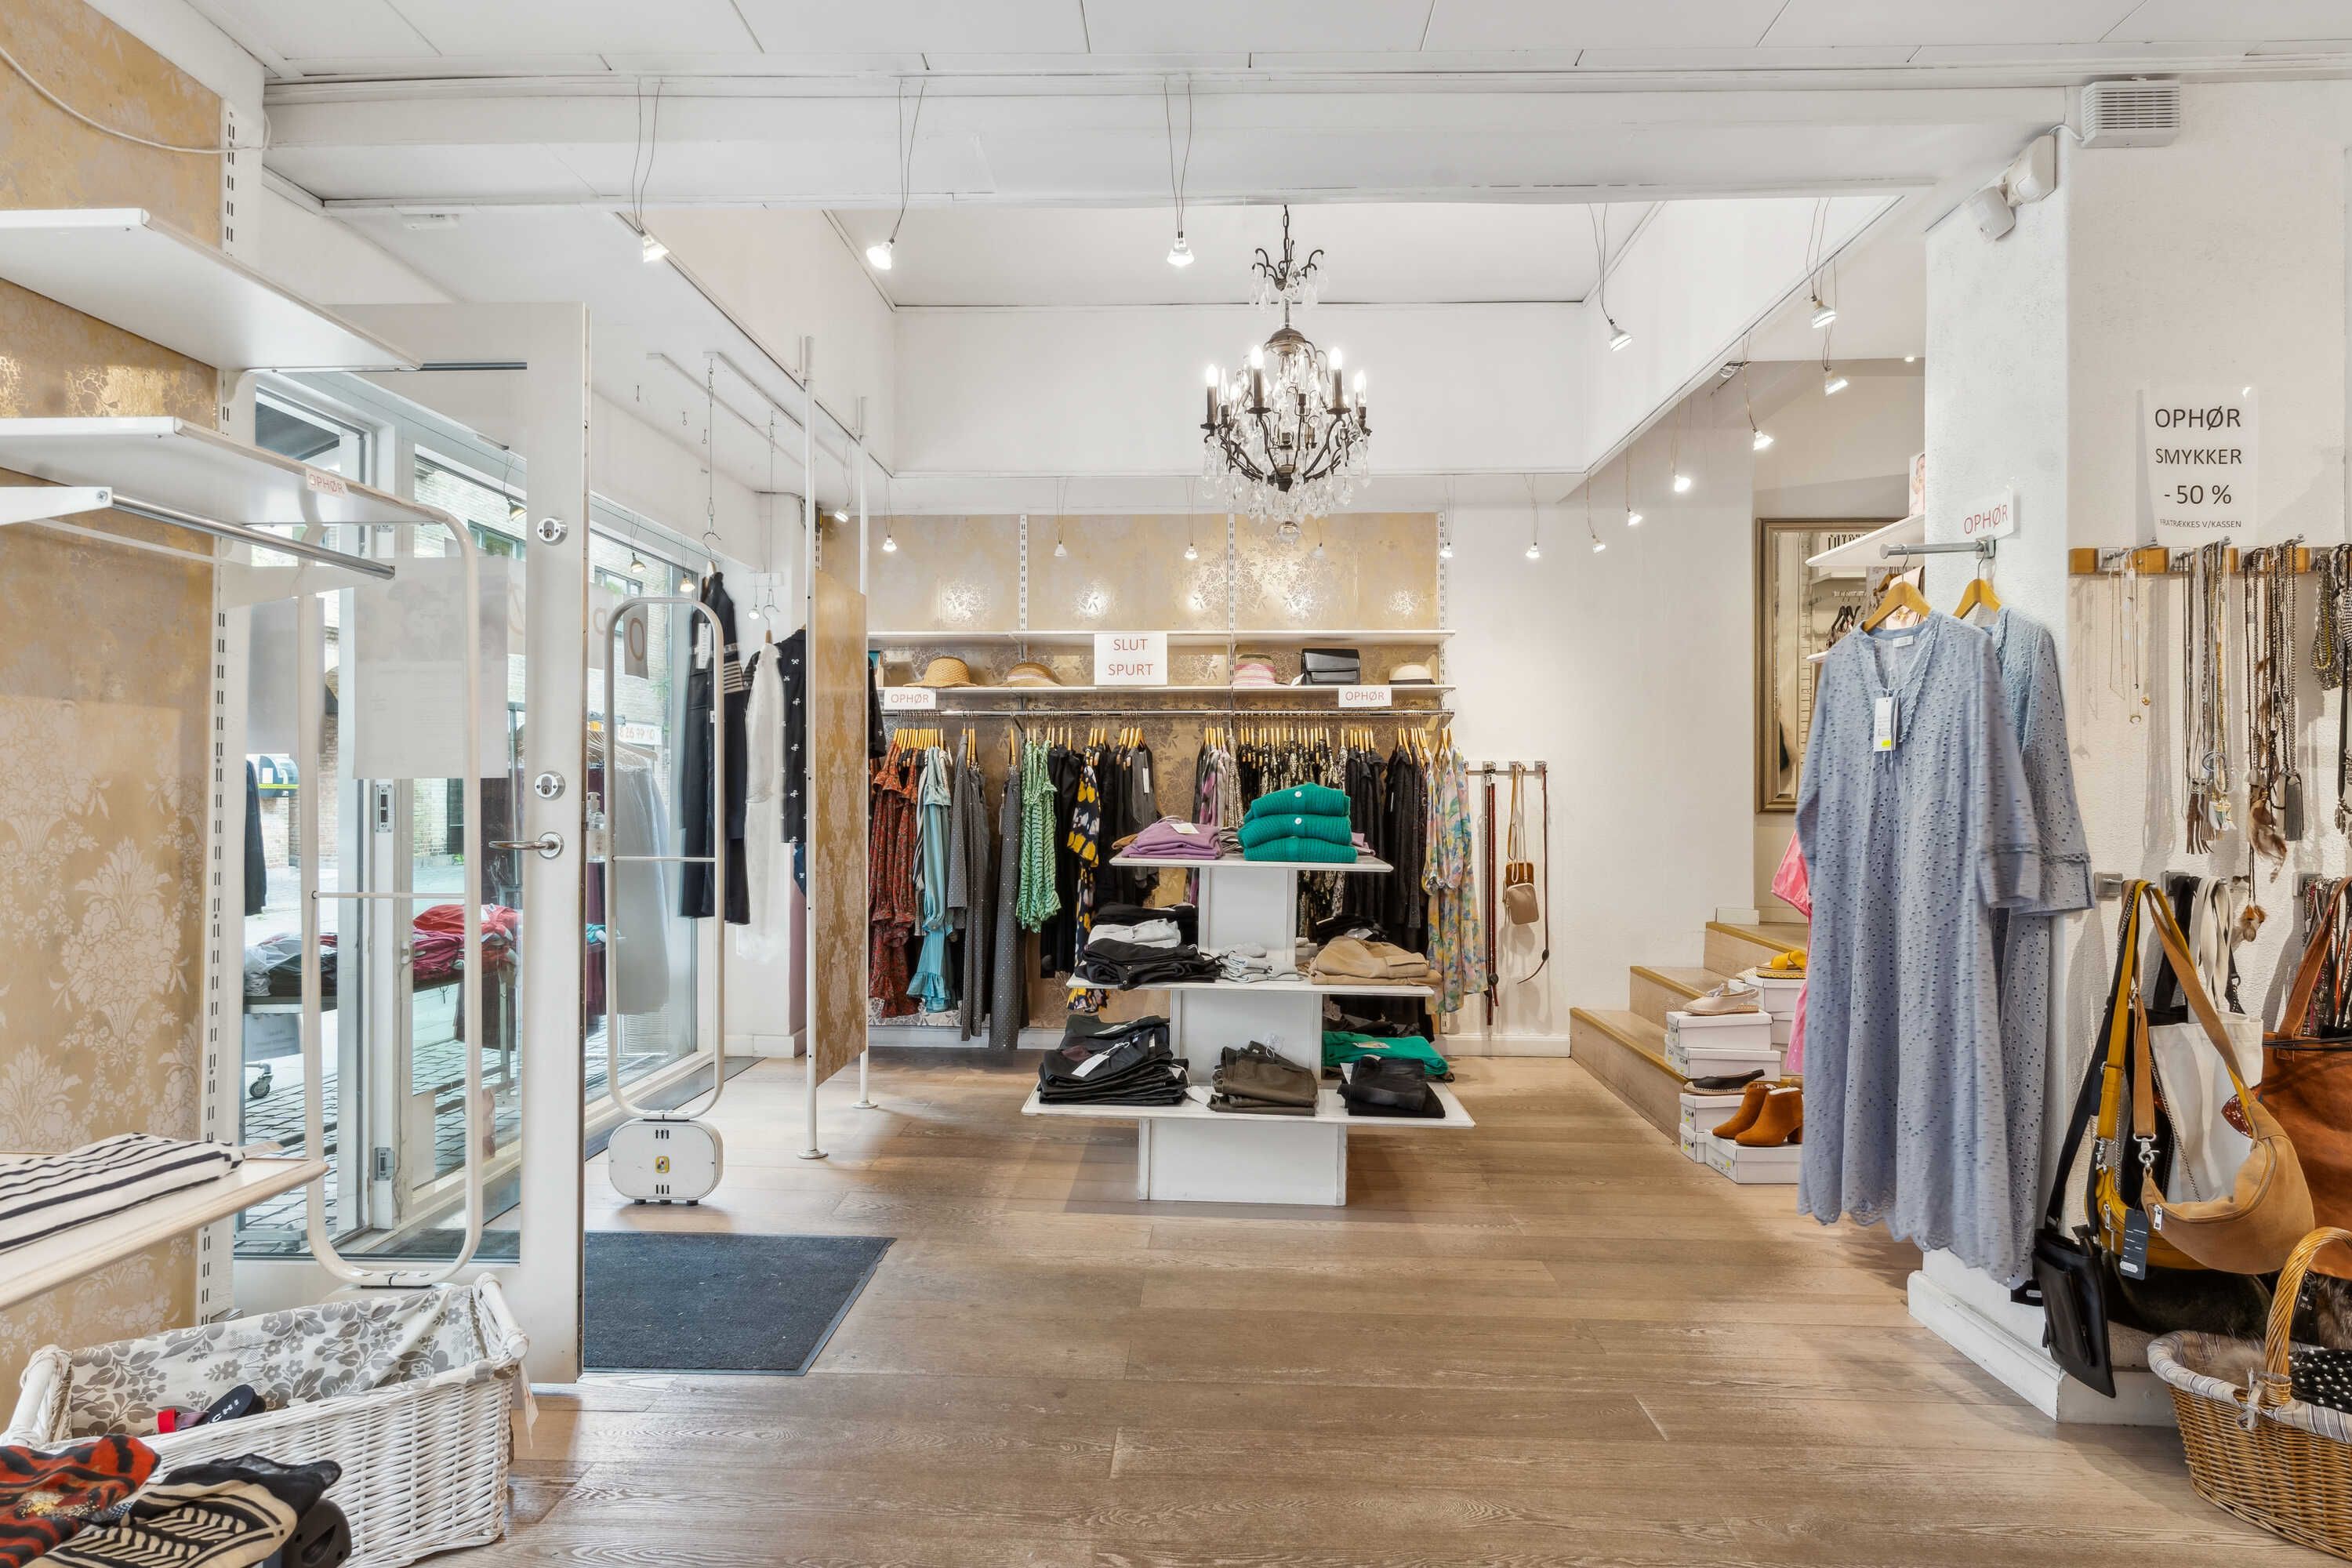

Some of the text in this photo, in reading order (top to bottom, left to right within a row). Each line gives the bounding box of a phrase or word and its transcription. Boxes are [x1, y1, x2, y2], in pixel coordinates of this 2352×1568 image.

[2154, 405, 2241, 430] OPHØR
[2155, 448, 2242, 464] SMYKKER
[2176, 485, 2204, 504] 50
[1964, 503, 2008, 535] OPHØR
[2202, 520, 2241, 528] V/KASSEN
[1114, 639, 1149, 651] SLUT
[1108, 663, 1154, 676] SPURT
[891, 693, 929, 705] OPHØR
[1345, 690, 1385, 702] OPHØR
[207, 1399, 239, 1425] CHI
